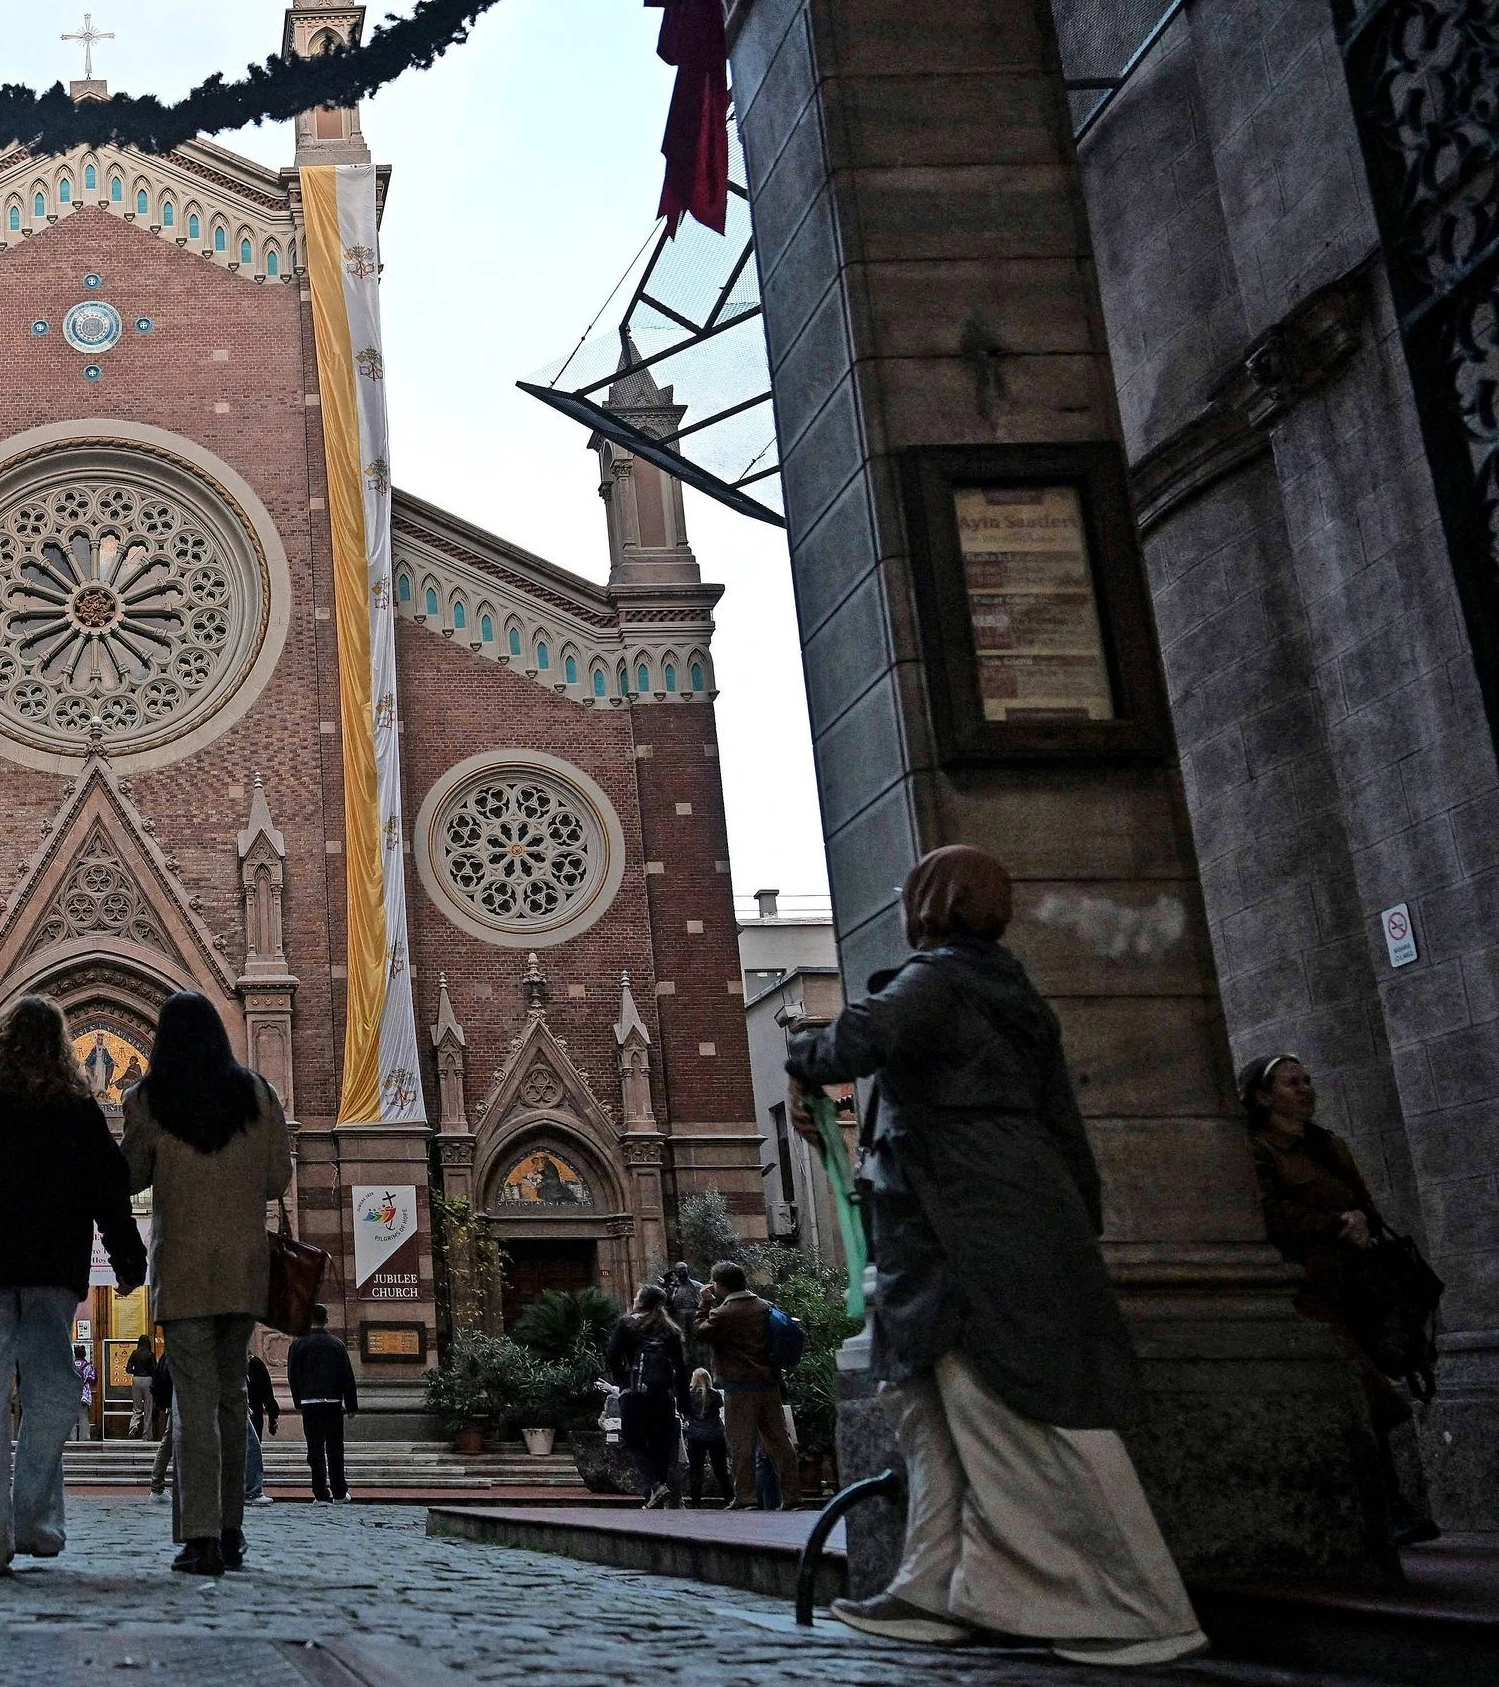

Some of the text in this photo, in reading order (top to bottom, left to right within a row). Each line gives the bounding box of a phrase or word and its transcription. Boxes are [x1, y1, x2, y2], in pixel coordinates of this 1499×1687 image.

[374, 1231, 401, 1242] PILGRIMS
[373, 1273, 418, 1284] JUBILEE
[371, 1287, 418, 1298] CHURCH
